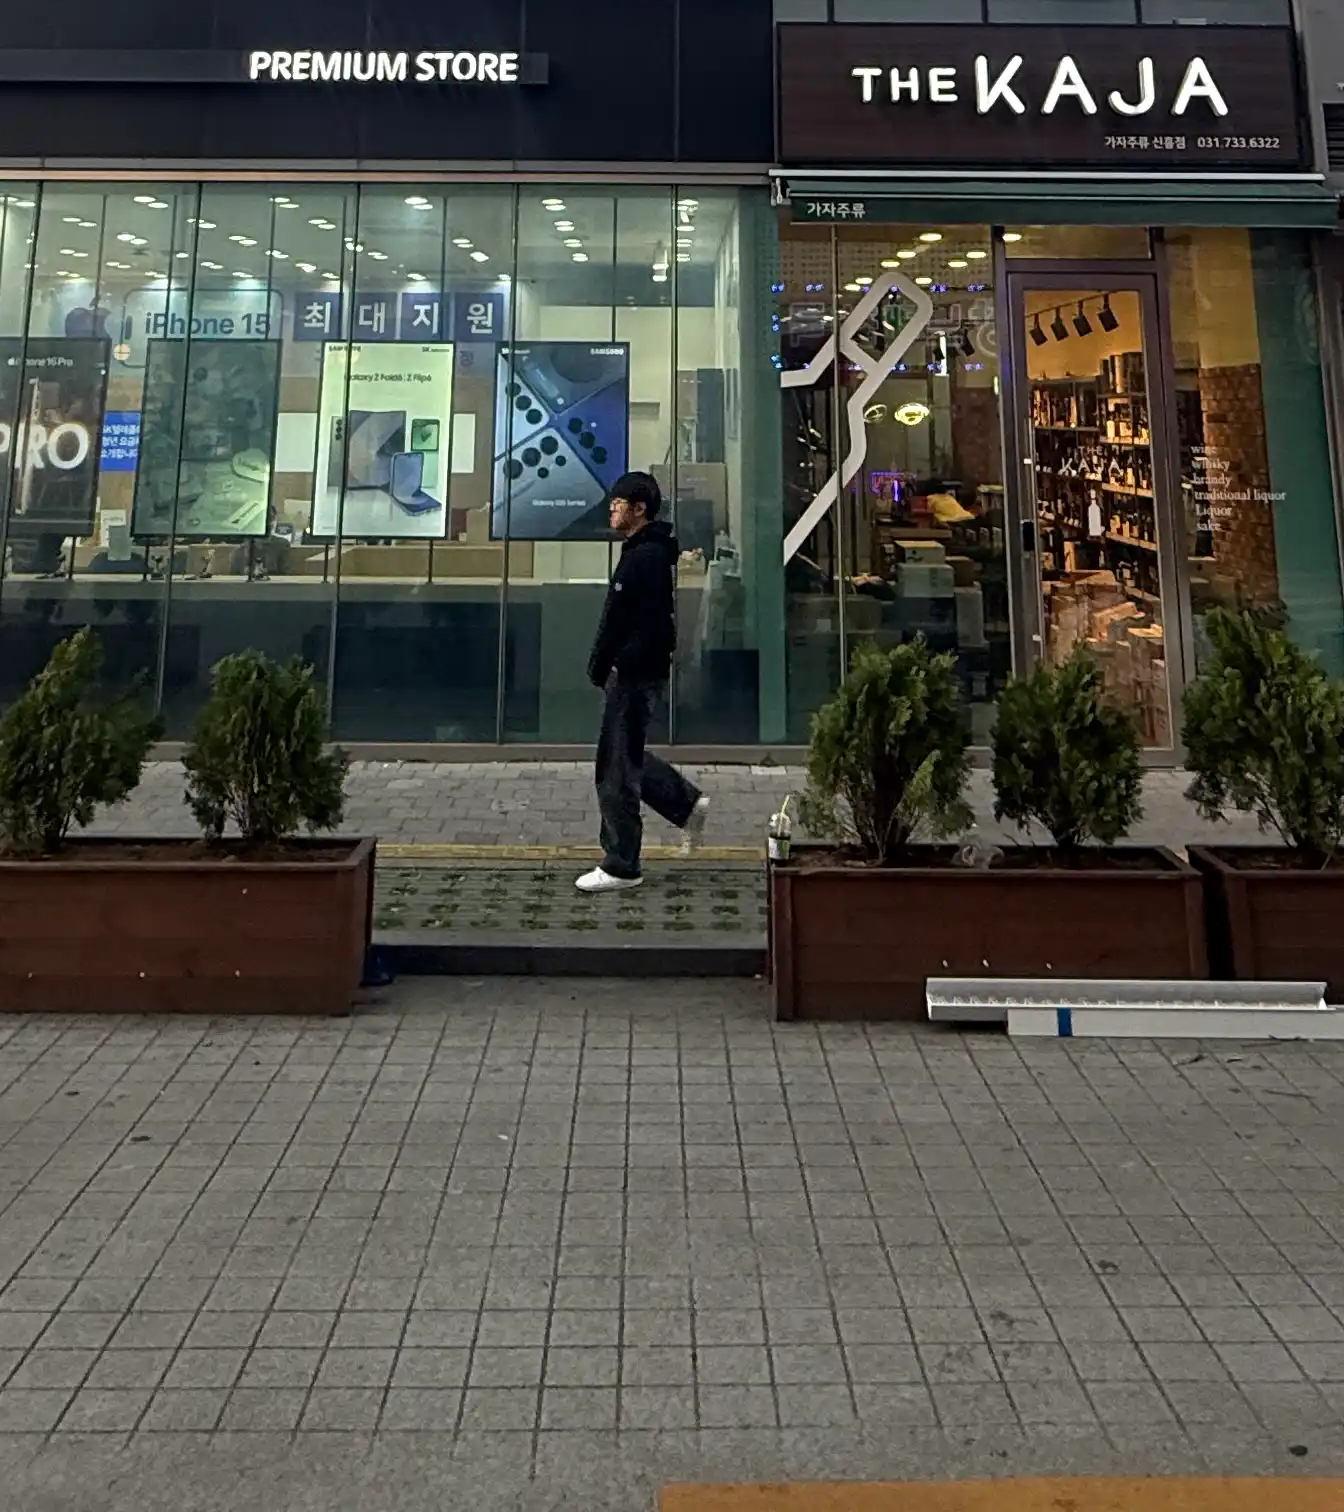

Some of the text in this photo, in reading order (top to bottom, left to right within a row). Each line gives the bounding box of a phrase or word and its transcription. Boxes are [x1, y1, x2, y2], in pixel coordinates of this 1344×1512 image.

[249, 50, 518, 83] PREMIUM STORE
[852, 53, 1229, 118] THE KAJA
[1105, 134, 1149, 150] 가자주류
[806, 201, 867, 219] 가자주류
[145, 311, 271, 336] iPhone 15
[304, 301, 494, 335] 최대지원
